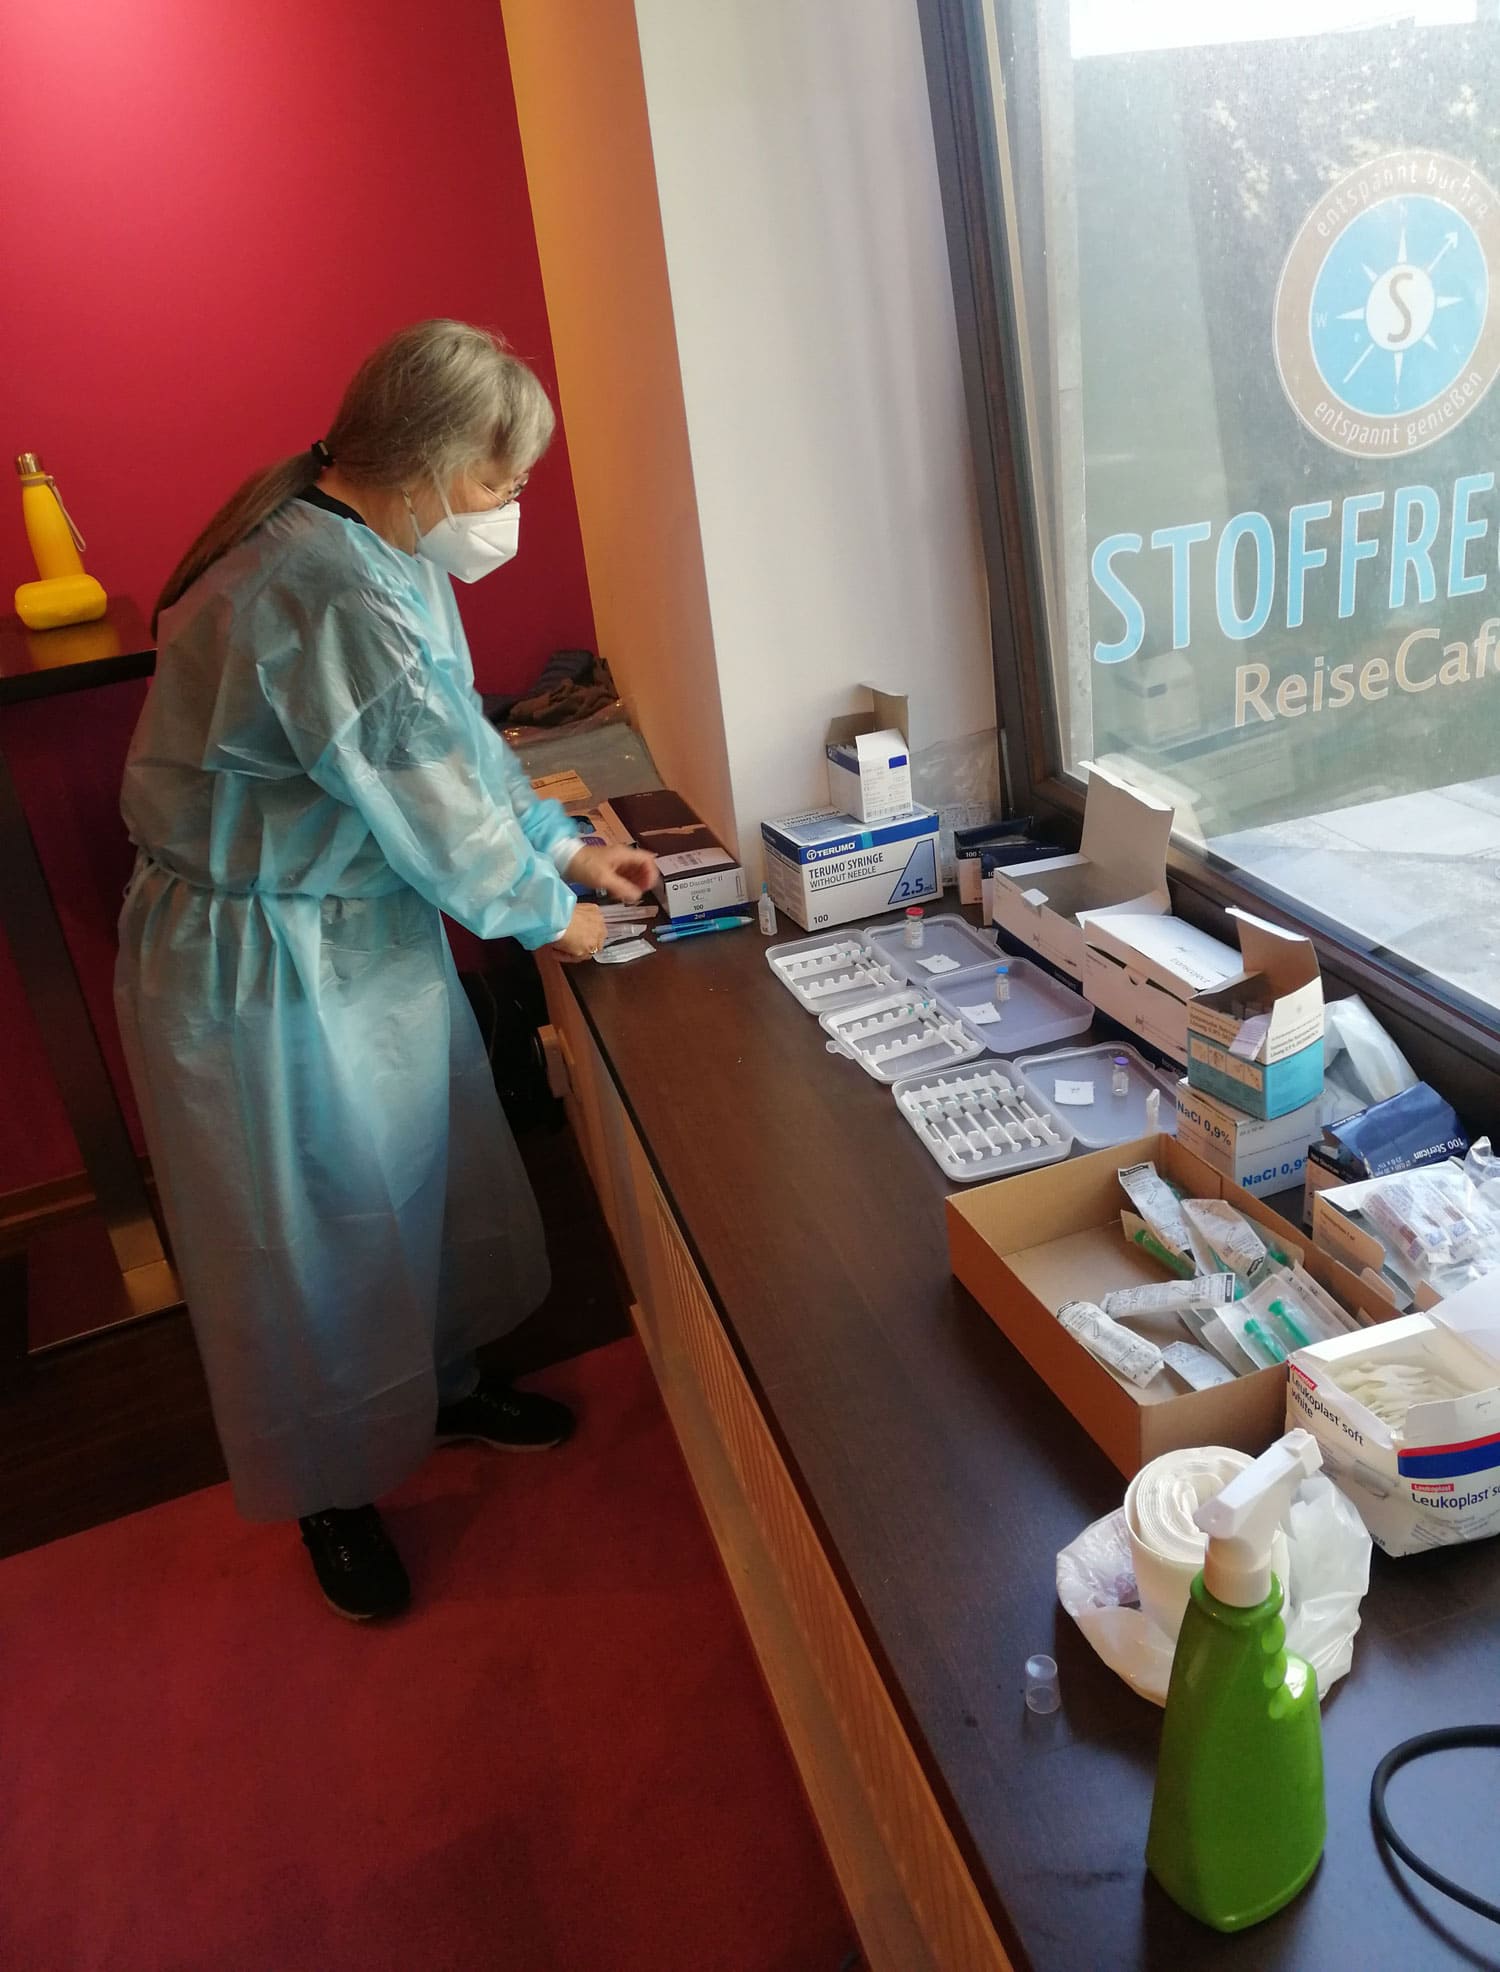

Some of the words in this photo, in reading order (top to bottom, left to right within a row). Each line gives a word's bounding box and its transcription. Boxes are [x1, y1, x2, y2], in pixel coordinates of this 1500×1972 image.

[1316, 161, 1417, 237] entspannt
[1314, 401, 1400, 445] entspannt
[1407, 370, 1483, 445] genießen
[1091, 471, 1500, 664] STOFFRE
[1235, 617, 1500, 728] ReiseCaf
[816, 841, 856, 857] TERUMO
[809, 861, 845, 880] TERUMO
[847, 852, 884, 870] SYRINGE
[810, 874, 847, 889] WITHOUT
[848, 865, 876, 880] NEEDLE
[814, 914, 829, 924] 100
[1177, 1100, 1201, 1125] NaCl
[1204, 1120, 1232, 1146] 0,9%
[1413, 1142, 1447, 1160] Sterican
[1447, 1136, 1464, 1150] 100
[1242, 1167, 1277, 1187] NaCl
[1291, 1387, 1313, 1418] white
[1292, 1372, 1340, 1426] Leukoplast
[1342, 1423, 1364, 1447] soft
[1411, 1489, 1489, 1510] Leukoplast
